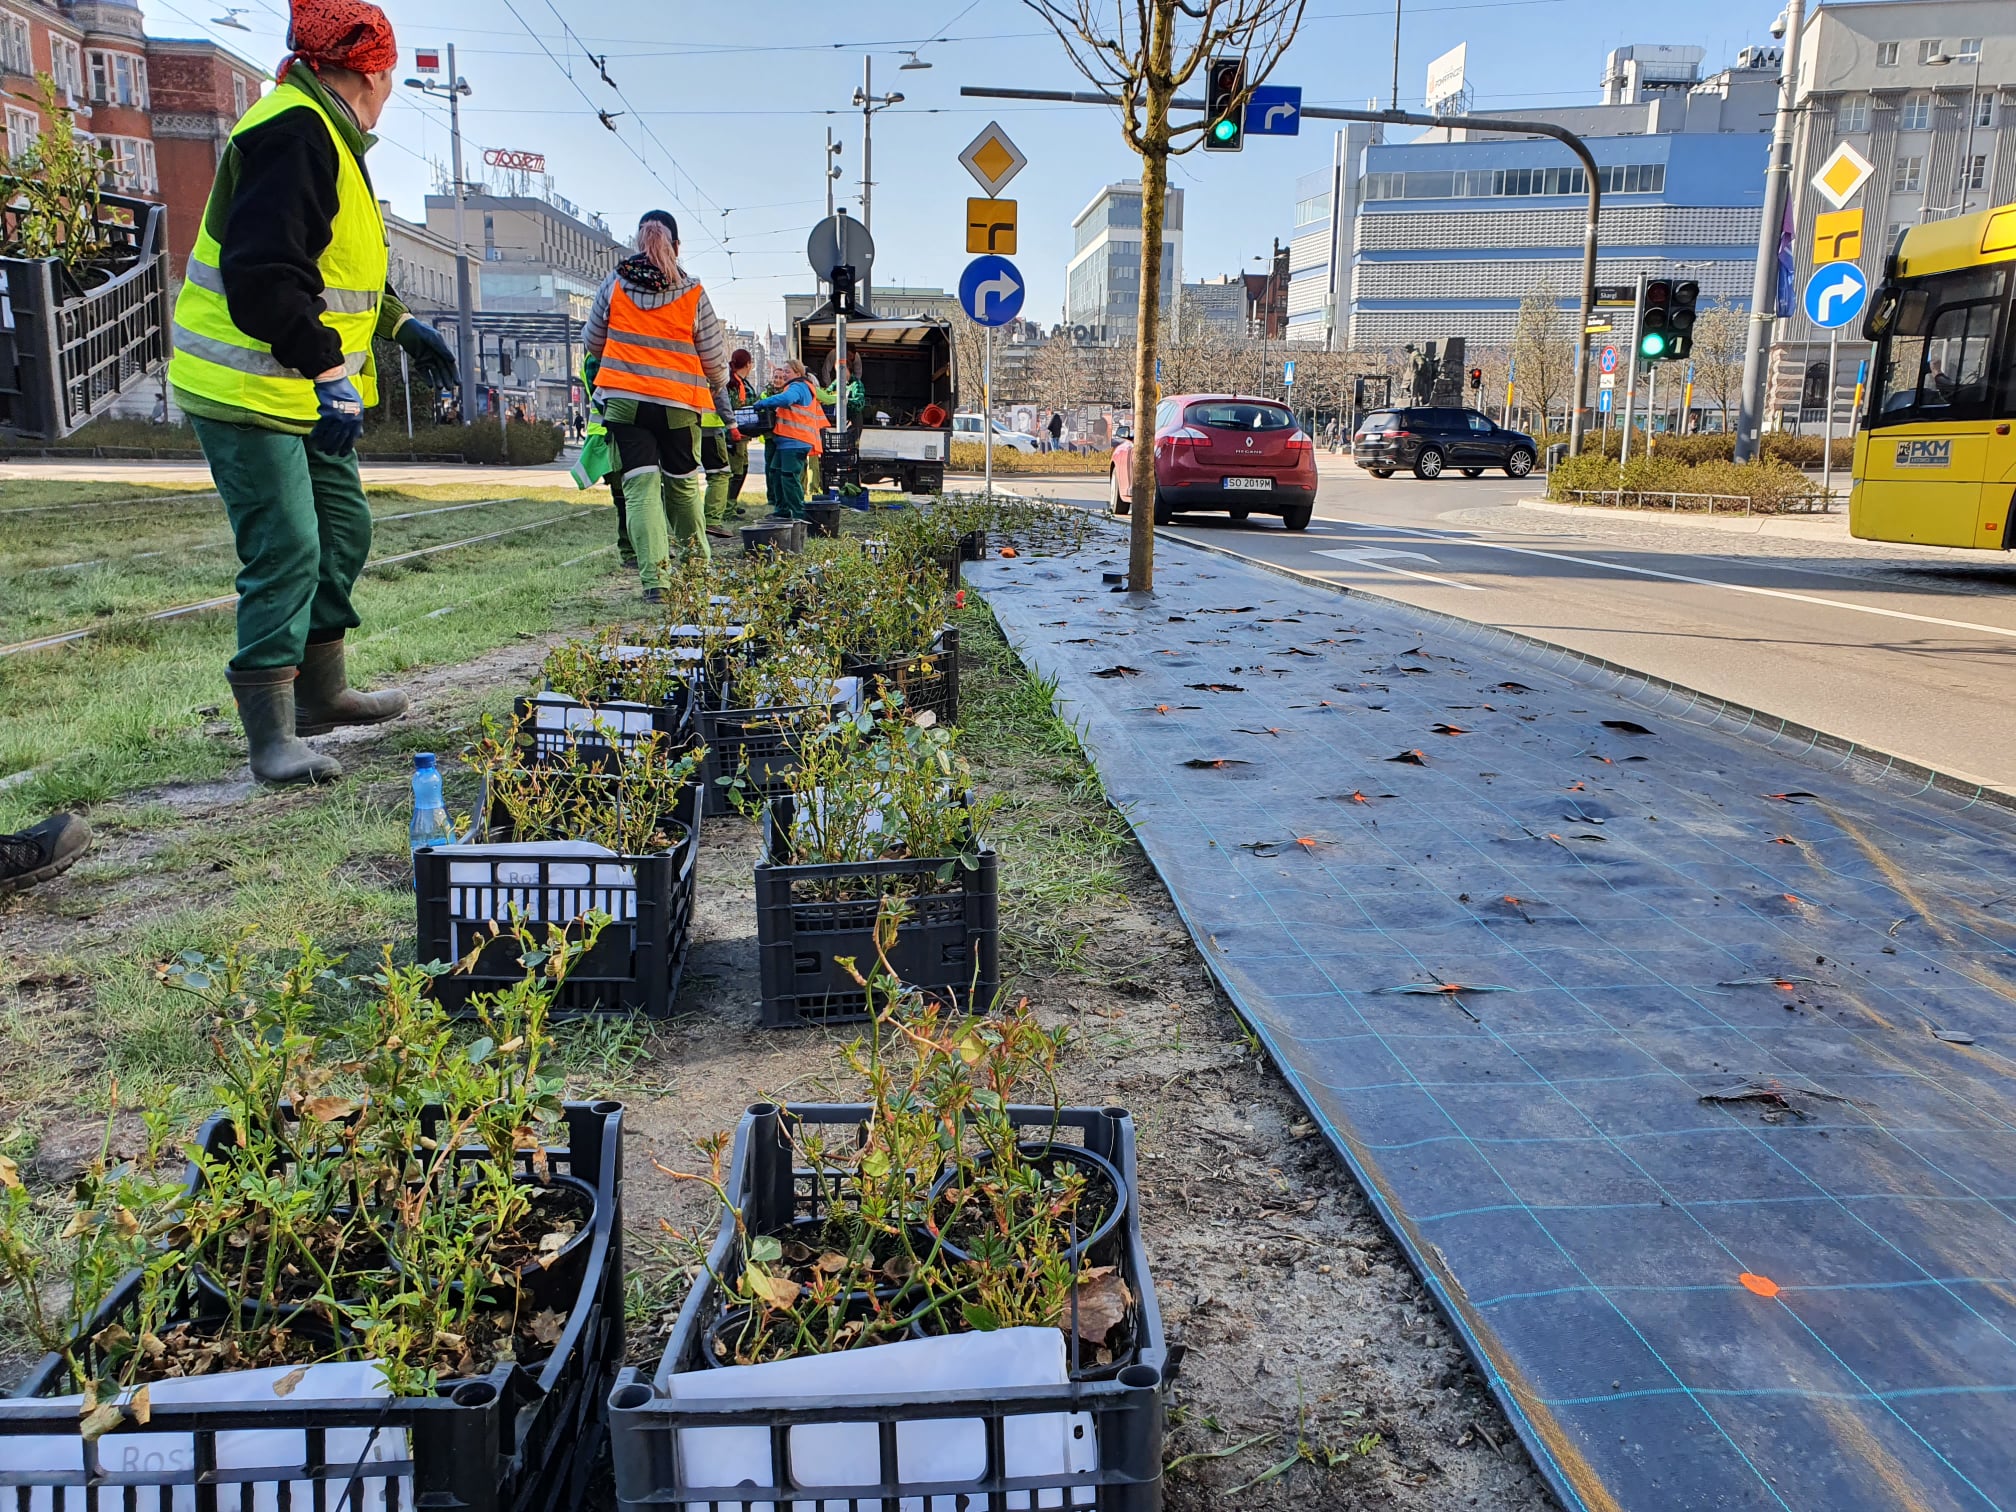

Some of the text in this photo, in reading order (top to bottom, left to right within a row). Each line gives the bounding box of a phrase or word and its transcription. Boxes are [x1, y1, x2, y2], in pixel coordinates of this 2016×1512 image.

[1910, 440, 1950, 456] PKM
[1229, 478, 1271, 489] SO 2019M
[510, 871, 540, 885] Ros
[122, 1446, 195, 1473] Ros
